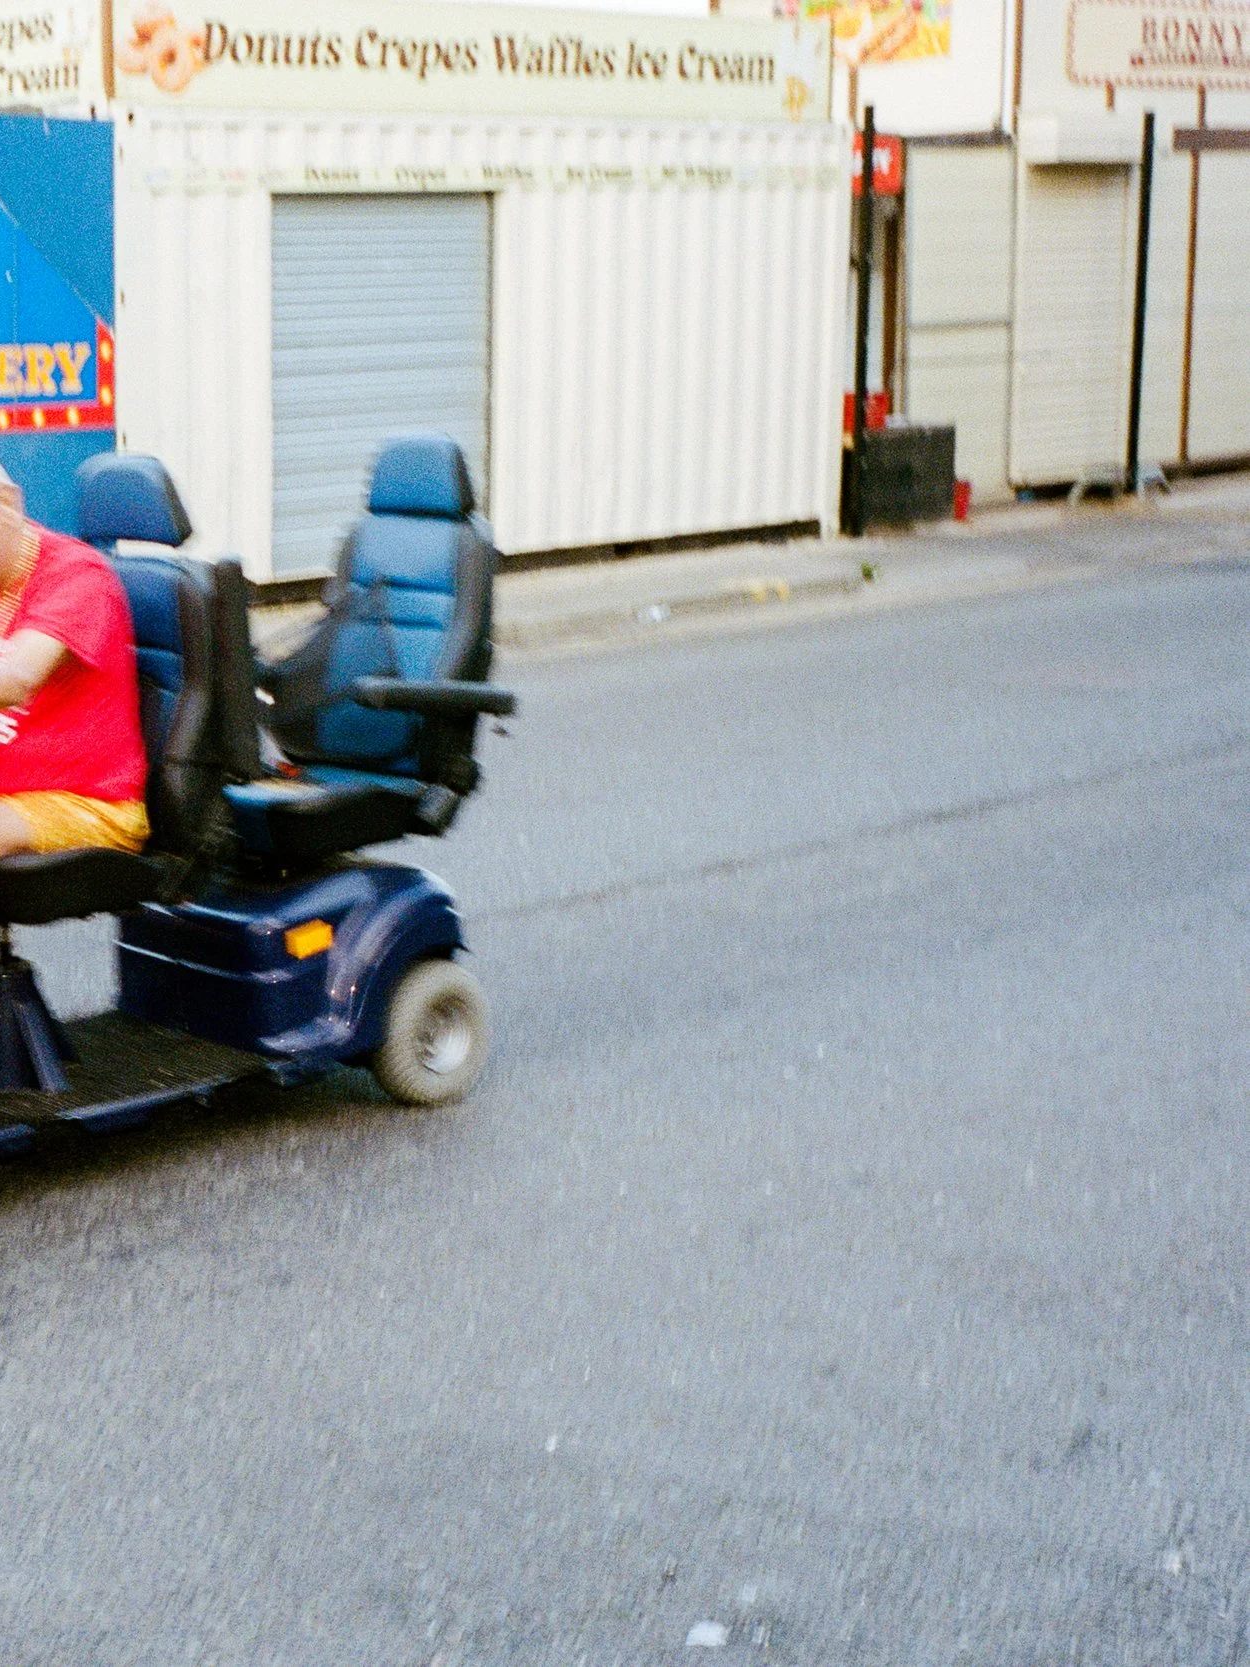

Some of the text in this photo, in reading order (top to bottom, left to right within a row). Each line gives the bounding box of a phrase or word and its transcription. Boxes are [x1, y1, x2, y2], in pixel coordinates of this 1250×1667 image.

[202, 17, 776, 85] Donuts Crepes Waffles Ice Cream
